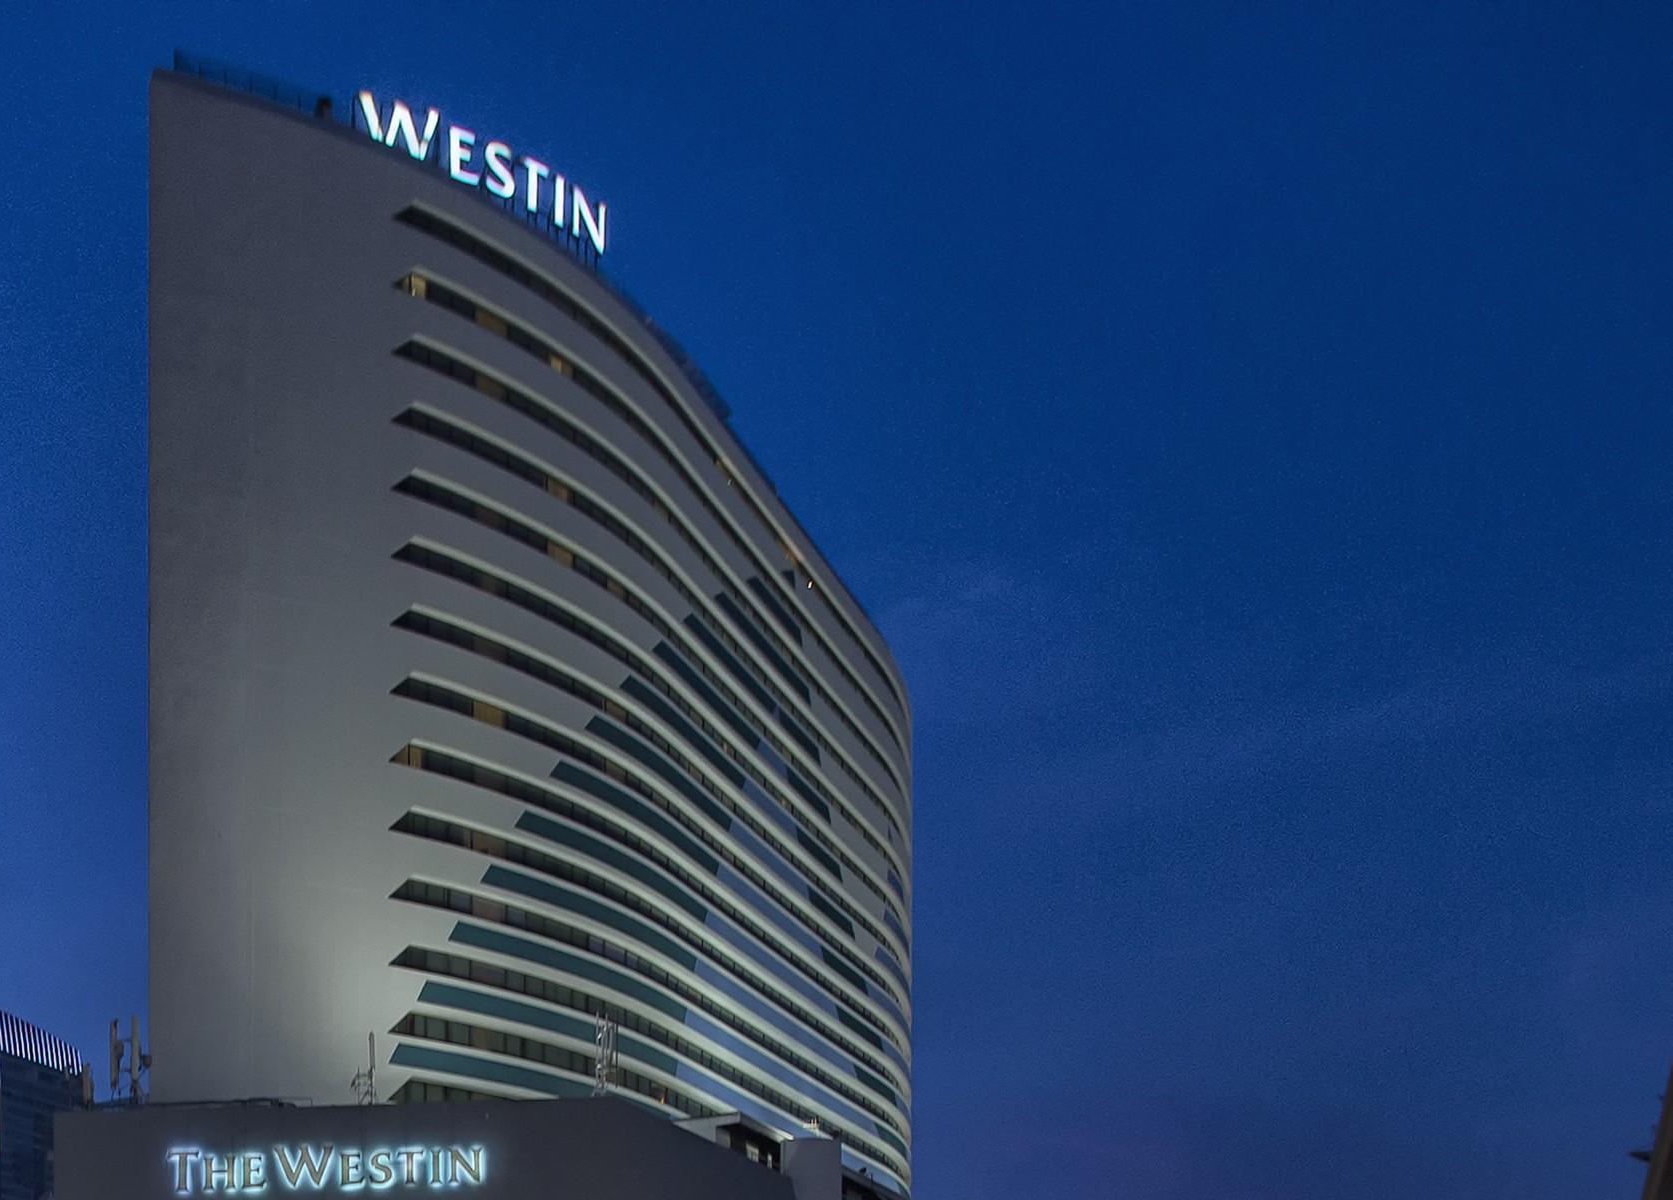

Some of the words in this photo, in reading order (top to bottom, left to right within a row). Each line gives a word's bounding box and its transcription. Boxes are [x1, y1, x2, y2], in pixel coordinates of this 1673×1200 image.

[358, 90, 607, 255] WESTIN
[166, 1149, 267, 1194] THE
[272, 1143, 486, 1190] WESTIN
